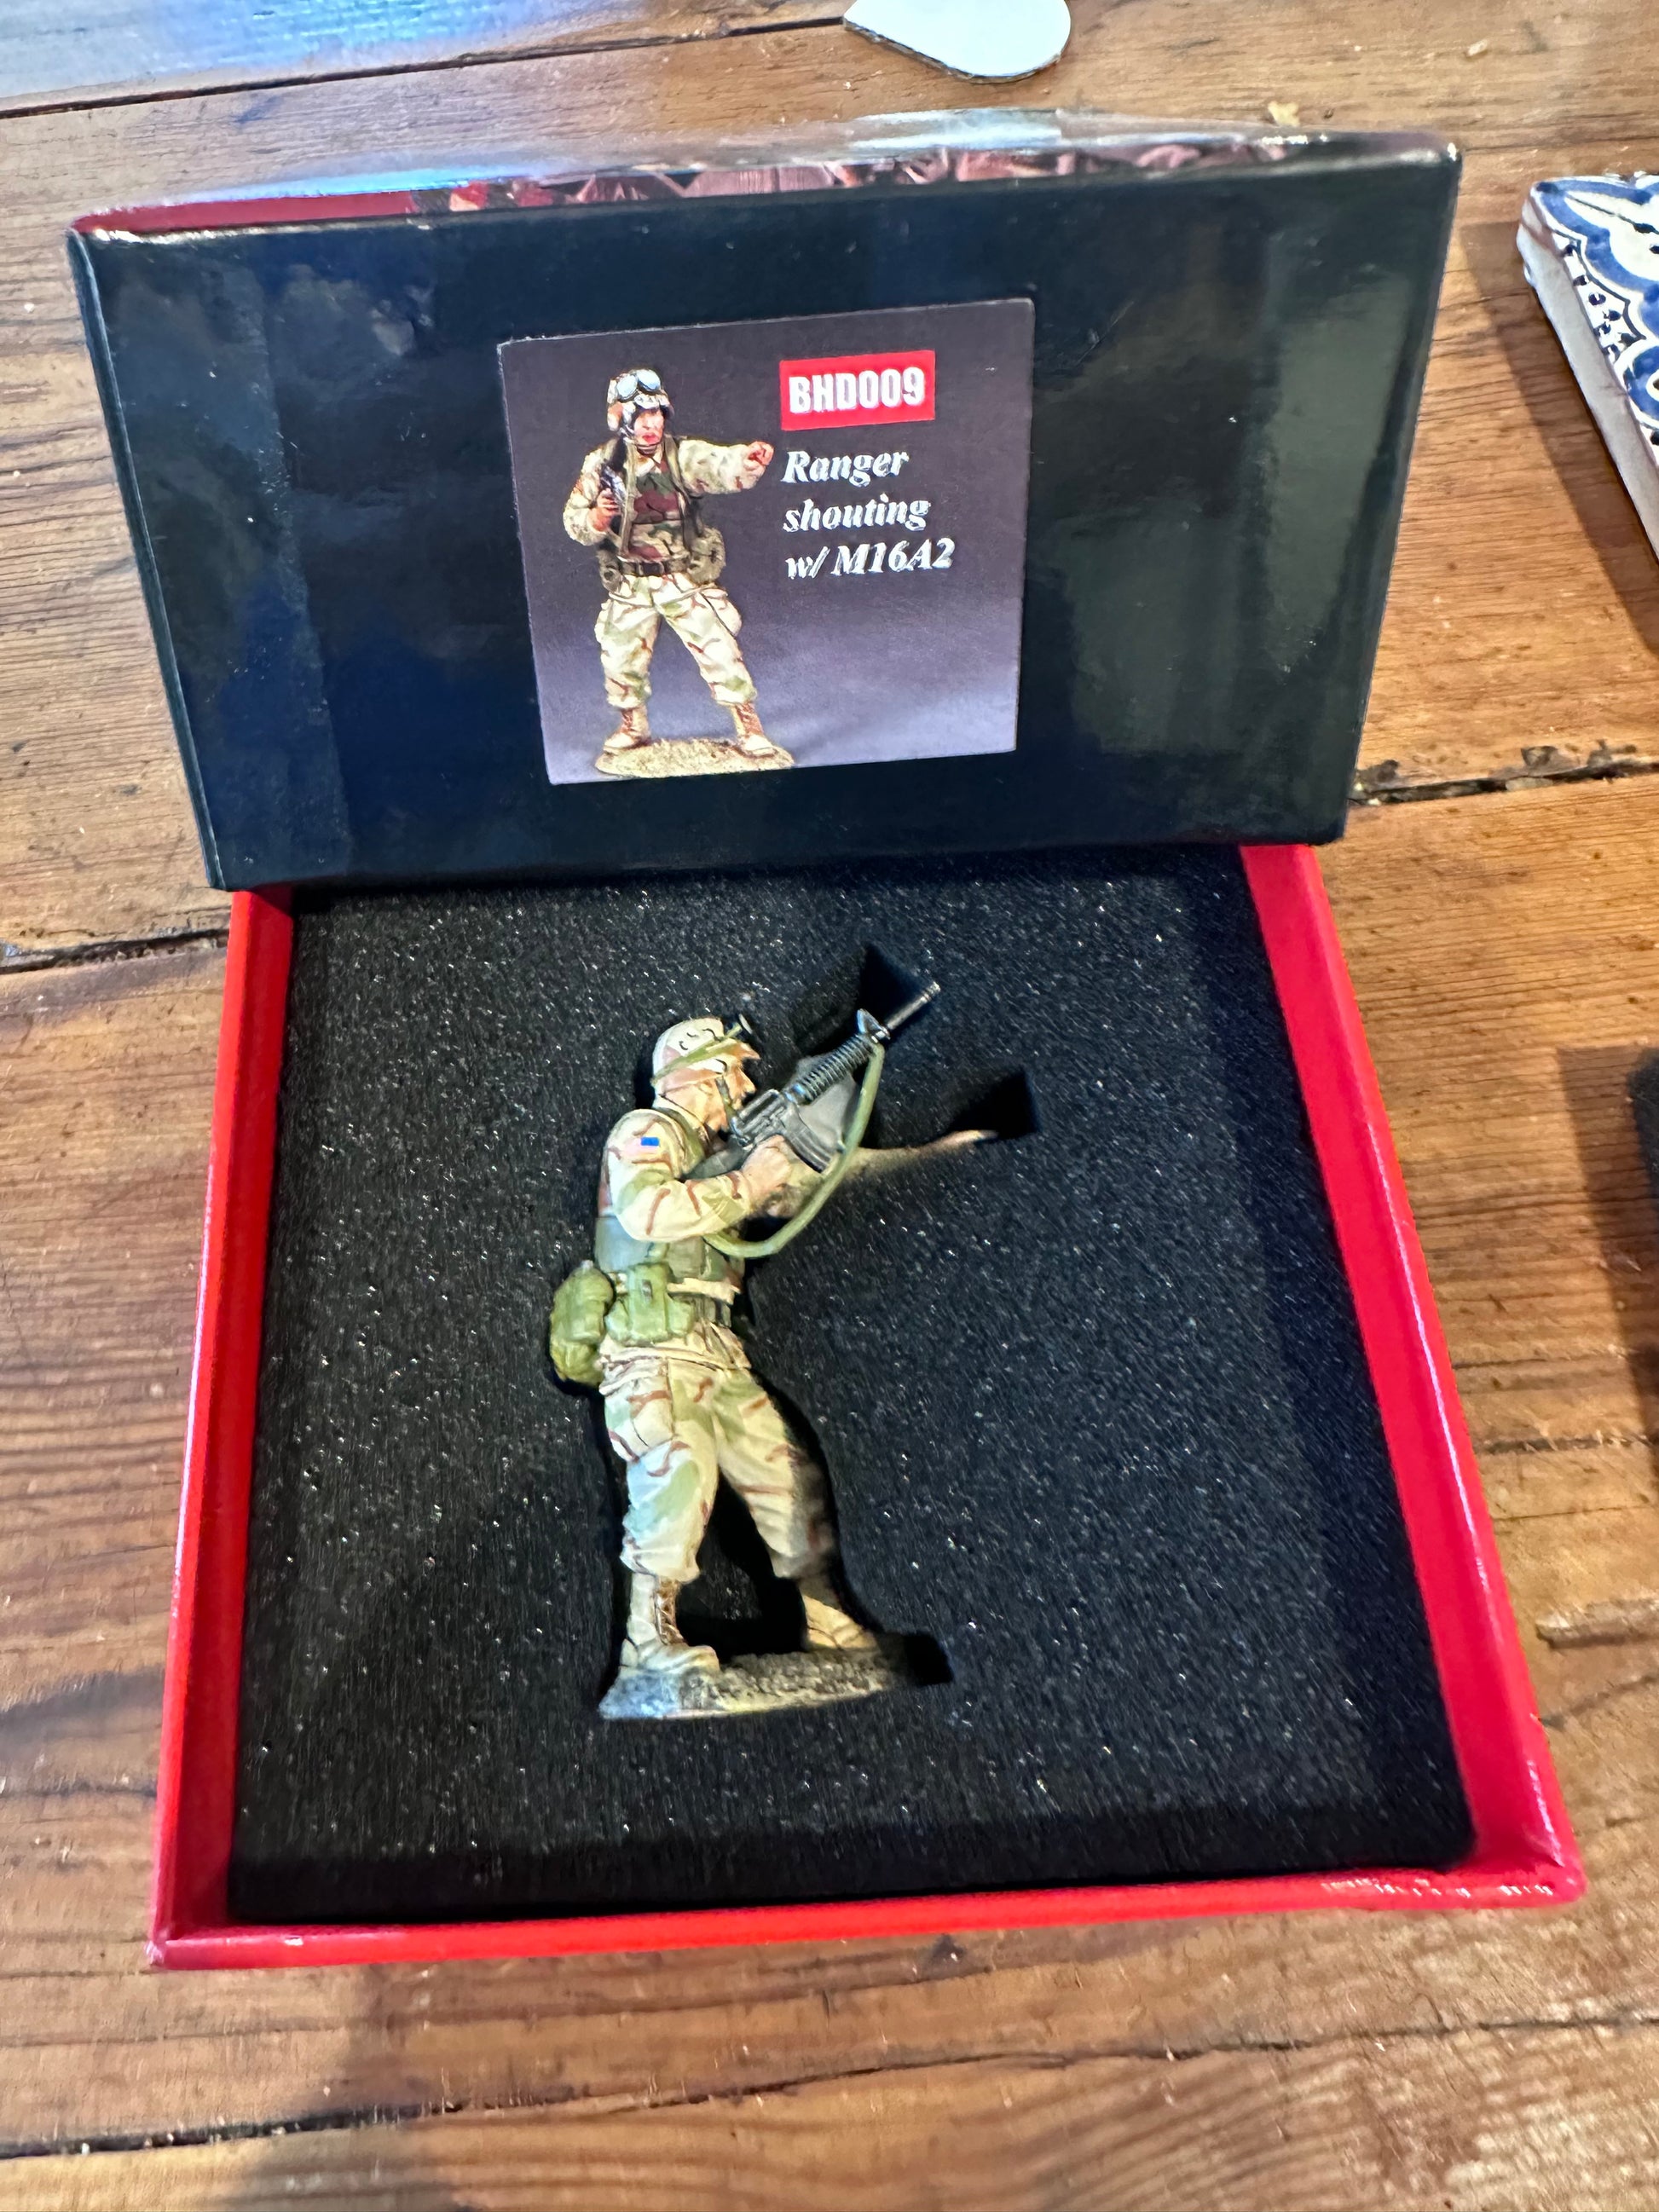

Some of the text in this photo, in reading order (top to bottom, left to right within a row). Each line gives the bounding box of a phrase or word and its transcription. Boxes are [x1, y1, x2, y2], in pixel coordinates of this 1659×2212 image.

[789, 367, 925, 414] BHD009
[780, 450, 910, 487] Ranger
[783, 493, 931, 532] shouting
[784, 537, 956, 580] w/ M16A2
